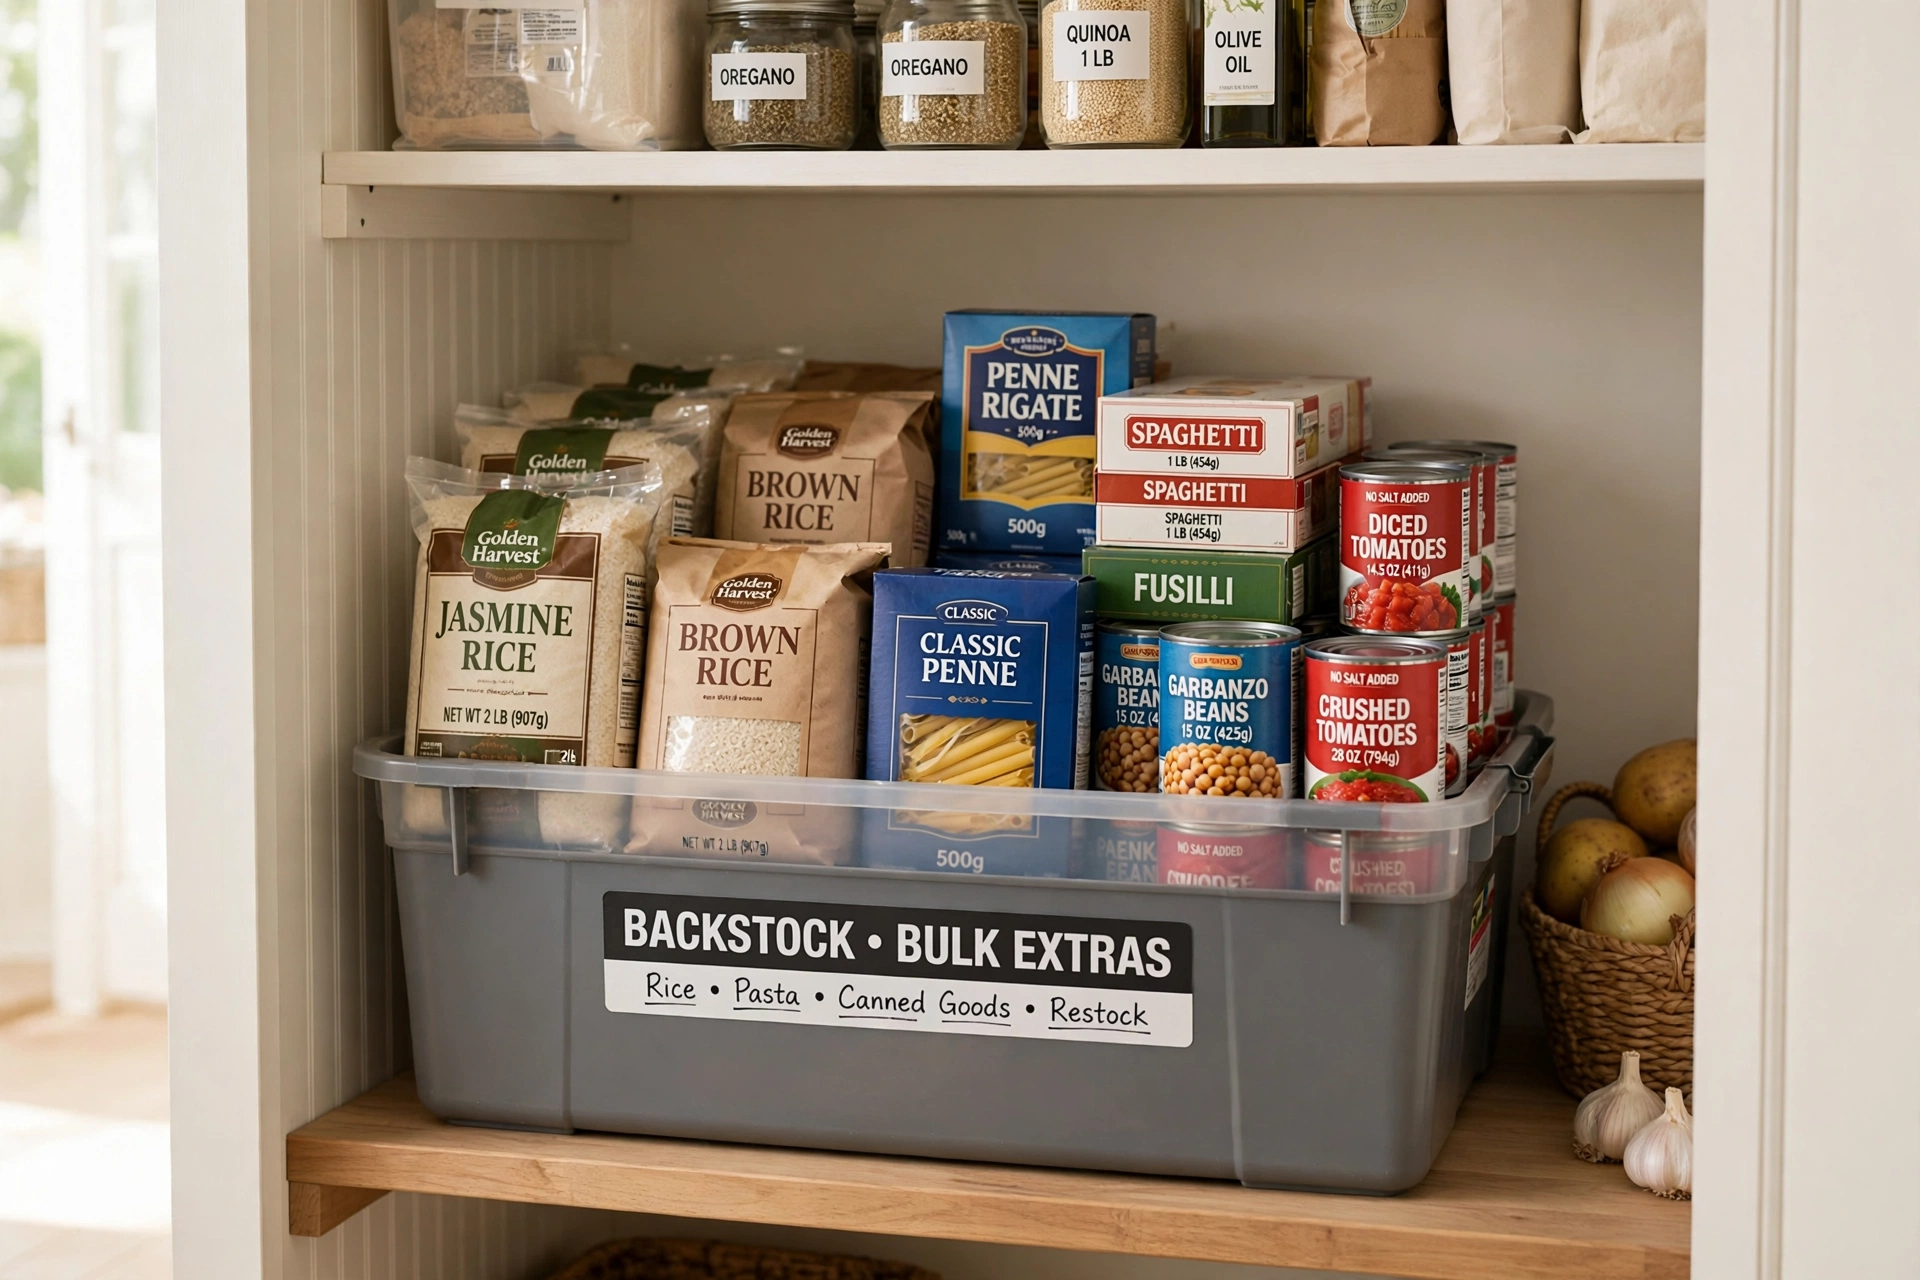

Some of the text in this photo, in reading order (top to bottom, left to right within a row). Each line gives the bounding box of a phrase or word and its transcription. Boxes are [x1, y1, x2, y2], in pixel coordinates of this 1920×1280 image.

[1066, 24, 1132, 46] QUINOA
[1214, 30, 1262, 49] OLIVE
[890, 56, 968, 76] OREGANO
[1081, 49, 1114, 67] 1 LB
[1225, 56, 1252, 74] OIL
[720, 67, 795, 86] OREGANO
[987, 362, 1080, 391] PENNE
[981, 392, 1082, 421] RIGATE
[781, 437, 832, 448] Harvest
[785, 427, 832, 438] Golden
[1131, 421, 1258, 448] SPAGHETTI
[528, 454, 587, 469] Golden
[1167, 456, 1220, 470] 1 LB (454g)
[746, 470, 861, 502] BROWN
[1143, 480, 1247, 503] SPAGHETTI
[1366, 491, 1430, 503] NO SALT ADDED
[763, 502, 834, 531] RICE
[1165, 512, 1222, 526] SPAGHETTI
[1369, 513, 1428, 536] DICED
[477, 530, 539, 547] Golden
[1007, 518, 1046, 538] 500g
[1166, 527, 1221, 543] 1 LB (454g)
[472, 544, 540, 565] Harvest
[1351, 535, 1447, 561] TOMATOES
[1366, 563, 1431, 579] 14.5 OZ (411g)
[716, 587, 772, 600] Harvest
[723, 577, 773, 589] Golden
[1134, 572, 1234, 605] FUSILLI
[435, 600, 573, 639] JASMINE
[944, 606, 997, 621] CLASSIC
[678, 623, 801, 655] BROWN
[920, 632, 1021, 658] CLASSIC
[461, 640, 536, 673] RICE
[696, 657, 772, 687] RICE
[921, 657, 1017, 687] PENNE
[1102, 663, 1160, 687] GARBA
[1330, 670, 1399, 686] NO SALT ADDED
[1168, 674, 1268, 700] GARBANZO
[444, 706, 549, 730] NET WT 2 LB (907g)
[1116, 709, 1126, 723] 15
[1130, 710, 1145, 724] OZ
[1184, 700, 1249, 723] BEANS
[1319, 694, 1410, 721] CRUSHED
[1181, 723, 1252, 743] 15 OZ (425g)
[1316, 719, 1417, 747] TOMATOES
[1331, 747, 1400, 767] 28 OZ (794g)
[682, 836, 699, 850] NET
[703, 837, 715, 850] WT
[719, 838, 723, 851] 2
[727, 839, 737, 851] LB
[1177, 840, 1244, 857] NO SALT ADDED
[936, 849, 984, 874] 500g
[624, 907, 1172, 979] BACKSTOCK BULK EXTRAS
[646, 972, 1149, 1026] Rice Pasta Canned Goods Restock
